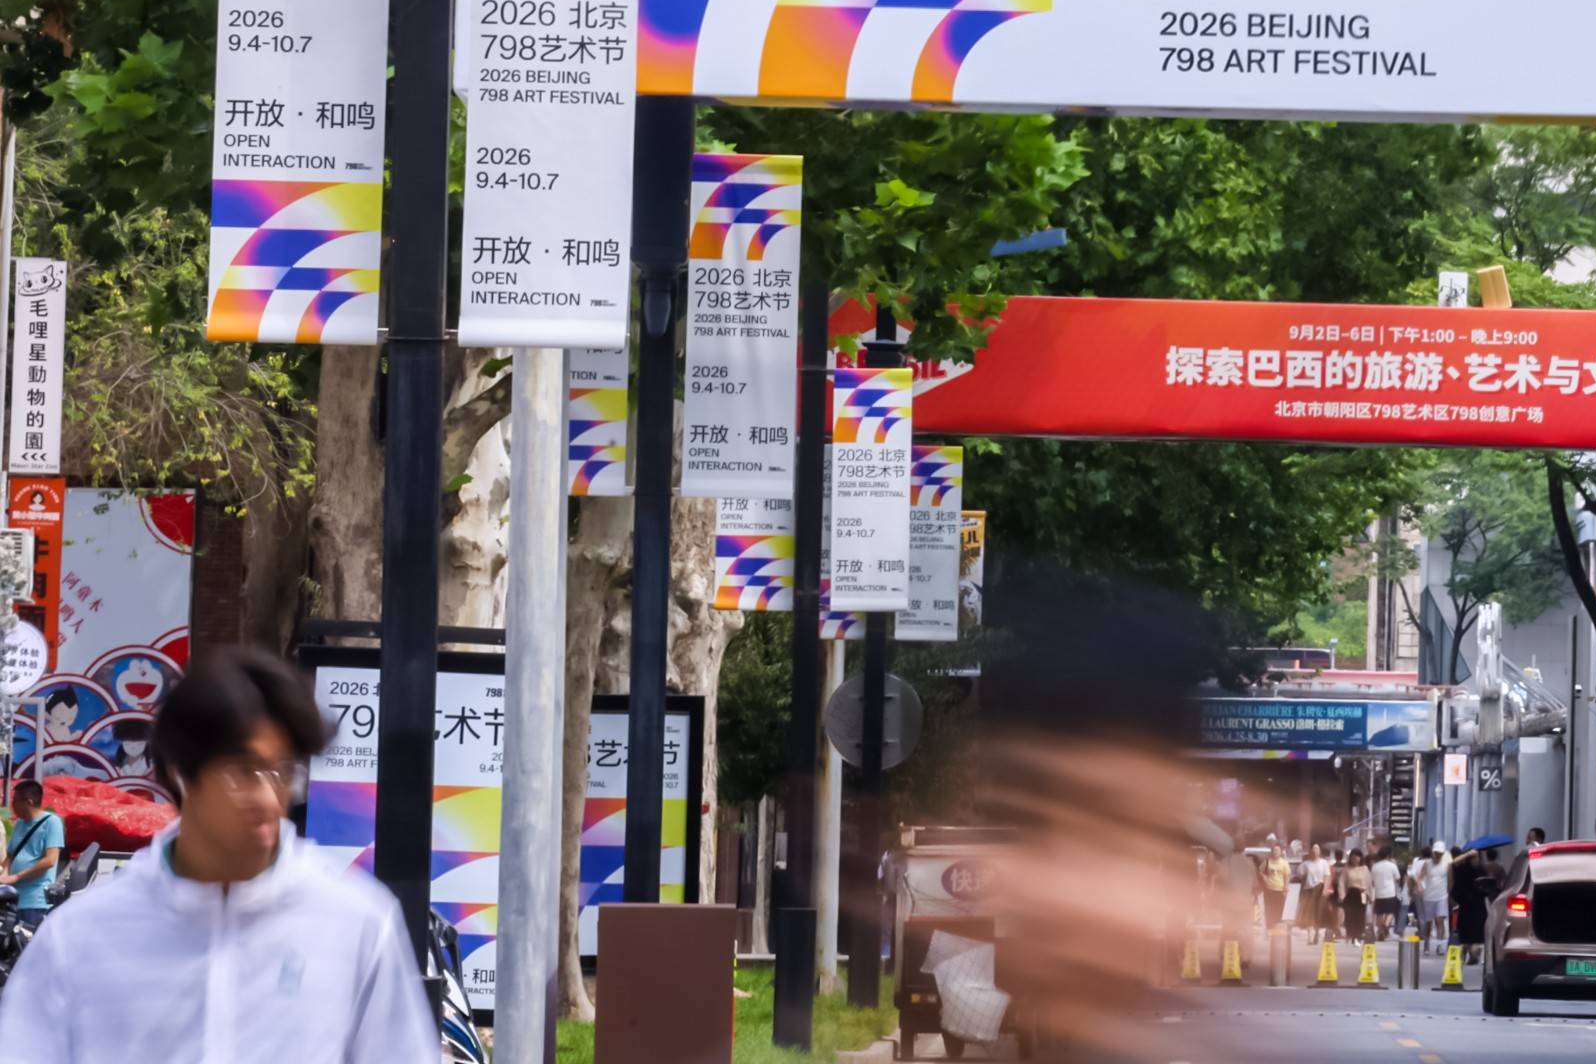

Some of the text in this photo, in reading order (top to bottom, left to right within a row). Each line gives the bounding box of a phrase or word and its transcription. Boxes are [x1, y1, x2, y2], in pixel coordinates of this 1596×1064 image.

[228, 9, 284, 29] 2026
[481, 0, 628, 30] 2026 北京
[1159, 11, 1370, 39] 2026 BEIJING
[228, 34, 313, 54] 9.4-10.7
[481, 34, 628, 65] 798艺术节
[1159, 47, 1437, 76] 798 ART FESTIVAL
[480, 68, 591, 85] 2026 BEIJING
[479, 88, 625, 105] 798 ART FESTIVAL
[223, 134, 270, 148] OPEN
[223, 153, 336, 170] INTERACTION
[476, 147, 531, 166] 2026
[476, 171, 560, 190] 9.4-10.7
[471, 271, 518, 285] OPEN
[695, 267, 793, 288] 2026 北京
[471, 290, 581, 307] INTERACTION
[694, 290, 792, 312] 798艺术节
[694, 313, 768, 325] 2026 BEIJING
[694, 326, 790, 338] 798 ART FESTIVAL
[1389, 326, 1454, 343] 下午1:00
[1471, 329, 1538, 345] 晚上9:00
[25, 298, 49, 450] 毛哩星動物的園
[692, 365, 729, 378] 2026
[691, 382, 747, 394] 9.4-10.7
[1275, 401, 1543, 423] 北京市朝阳区798艺术区798创意广场
[688, 448, 720, 458] OPEN
[838, 448, 905, 463] 2026 北京
[688, 461, 763, 472] INTERACTION
[838, 464, 905, 478] 798艺术节
[836, 518, 862, 527] 2026
[329, 681, 369, 696] 2026
[1255, 719, 1294, 730] GRASSO
[347, 758, 367, 768] ART
